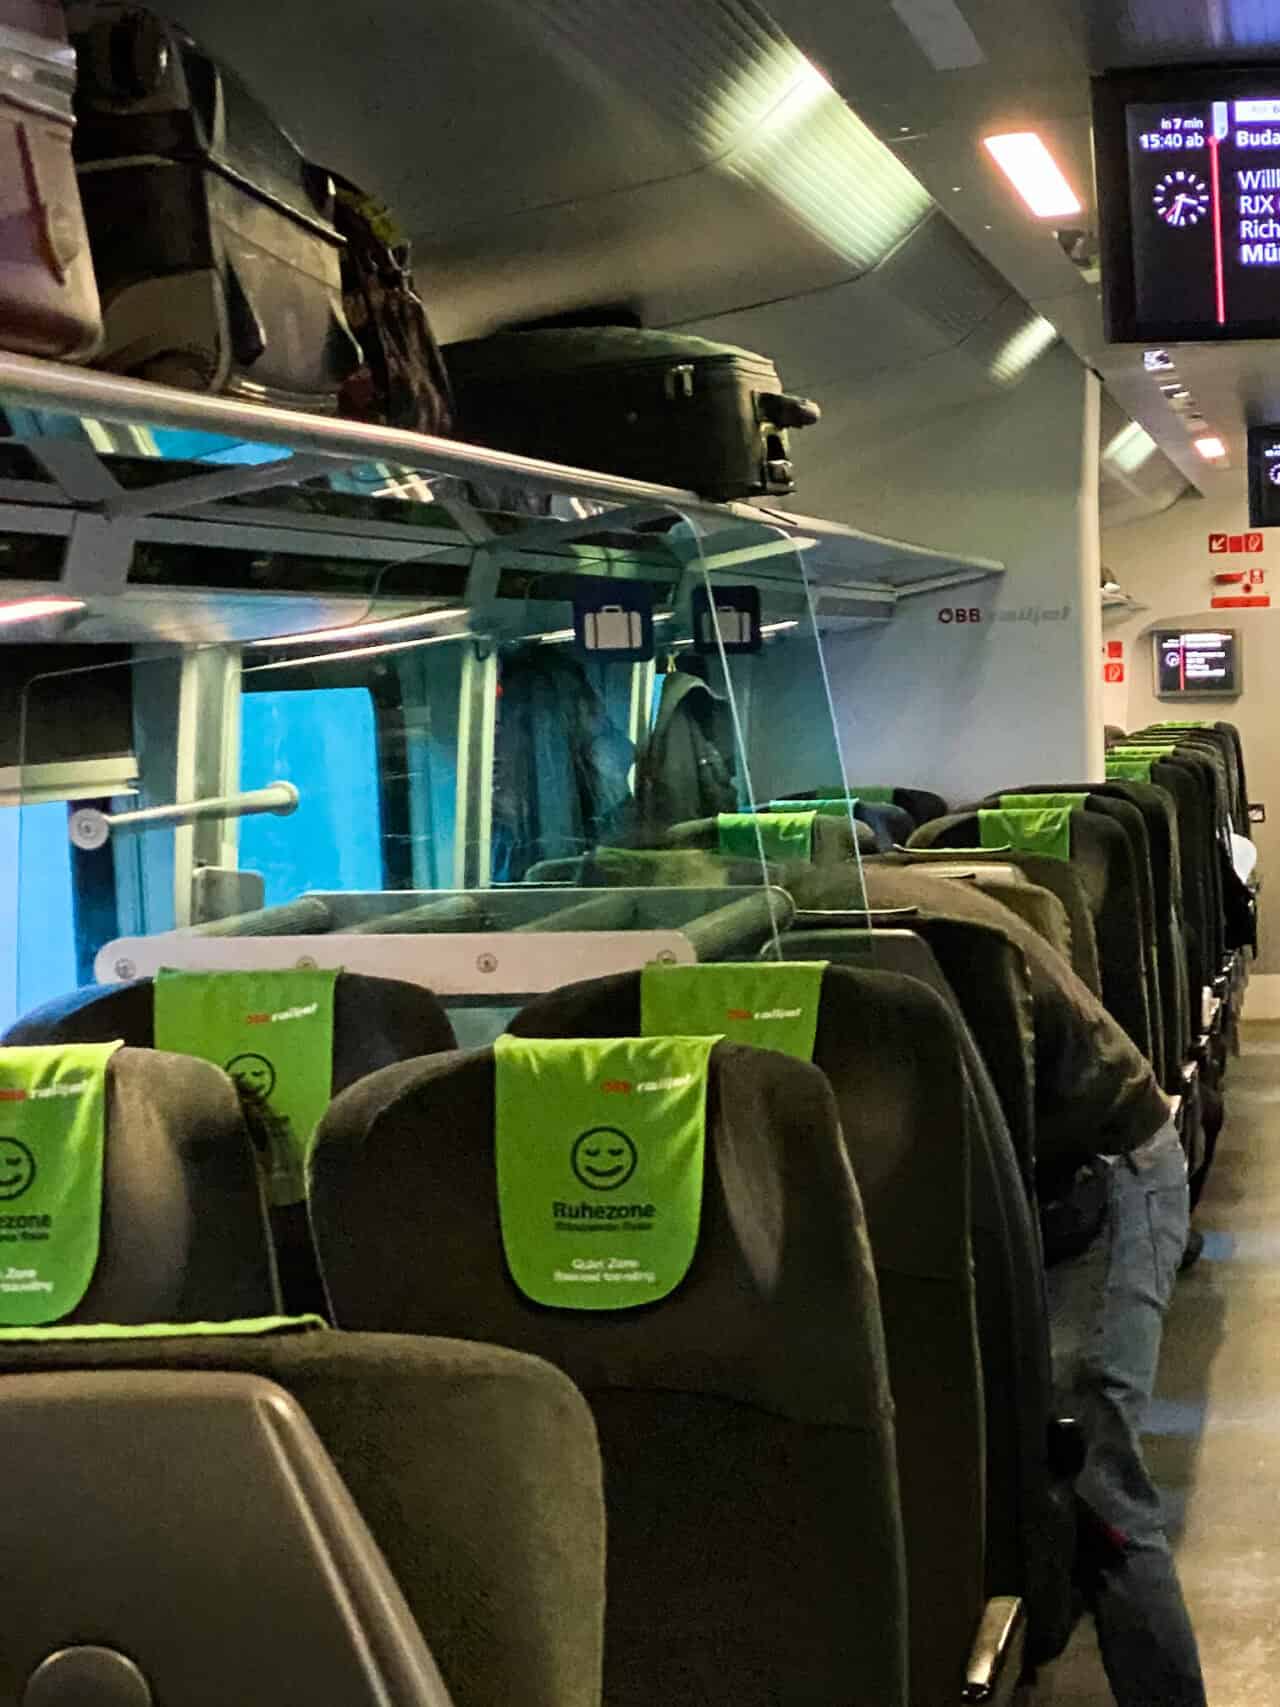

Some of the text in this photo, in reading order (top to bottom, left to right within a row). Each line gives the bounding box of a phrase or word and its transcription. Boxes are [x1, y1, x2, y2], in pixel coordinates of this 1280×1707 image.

[1173, 118, 1182, 130] 7
[1184, 117, 1204, 130] min
[1140, 133, 1204, 149] 15:40 ab
[1240, 194, 1274, 215] RJX
[553, 1201, 657, 1220] Ruhezone
